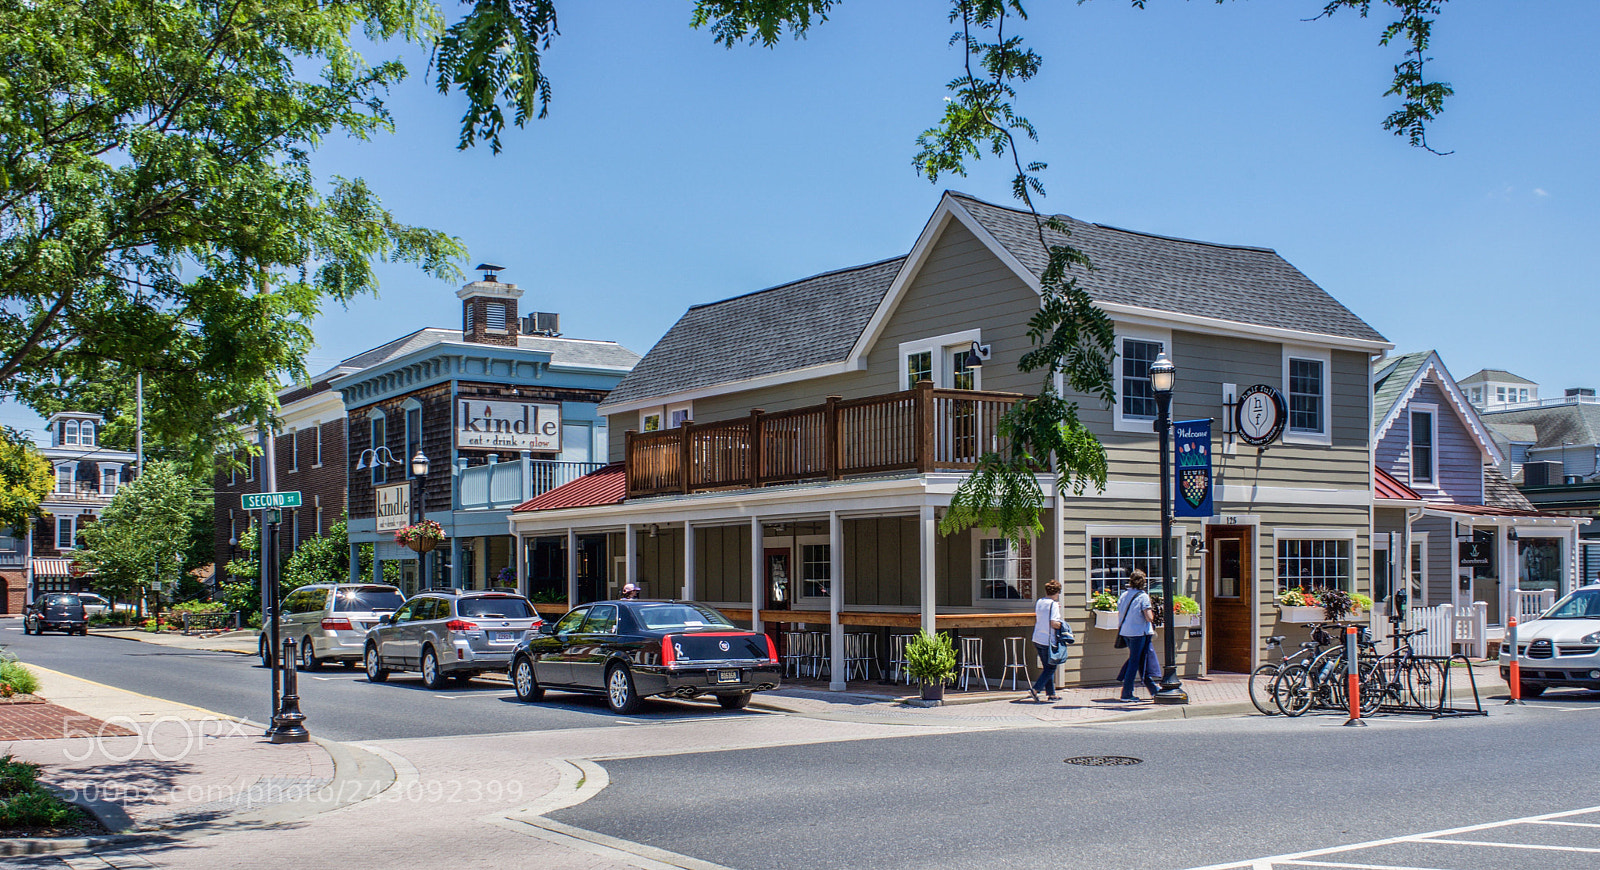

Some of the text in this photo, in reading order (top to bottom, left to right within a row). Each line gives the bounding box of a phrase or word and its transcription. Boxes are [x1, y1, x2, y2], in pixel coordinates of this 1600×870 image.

[1241, 385, 1276, 401] half full
[1254, 396, 1262, 409] h
[461, 401, 557, 436] kindle
[1255, 413, 1262, 425] f
[1177, 427, 1208, 438] Welcome
[469, 435, 550, 448] eat drink glow
[248, 494, 295, 507] SECOND ST
[376, 487, 409, 518] kindle
[1226, 516, 1237, 525] 125
